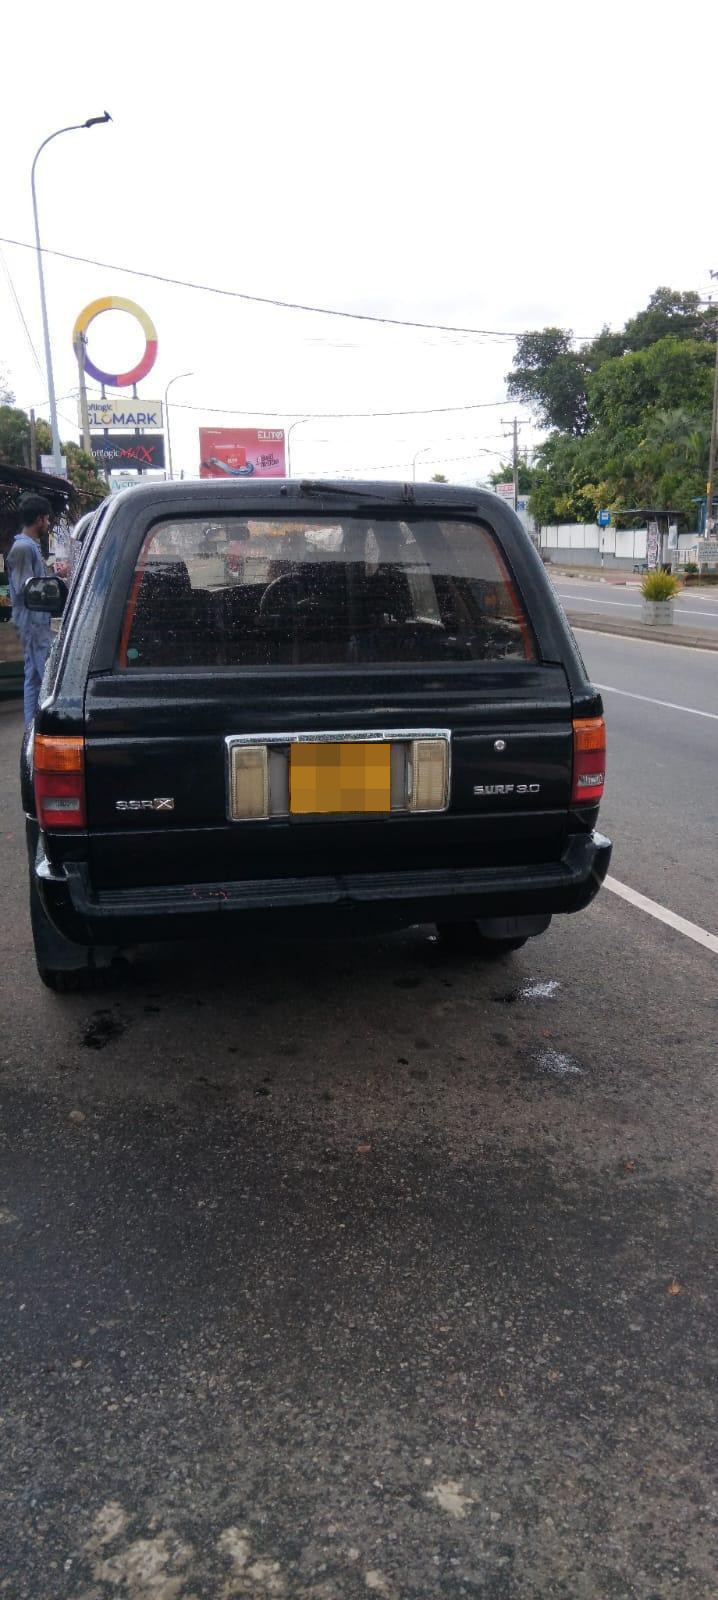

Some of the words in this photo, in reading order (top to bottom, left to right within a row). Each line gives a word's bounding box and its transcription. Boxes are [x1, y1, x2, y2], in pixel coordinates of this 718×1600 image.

[87, 403, 113, 412] oftlogic
[89, 447, 118, 460] oftlogic
[474, 784, 514, 795] SURF
[115, 798, 175, 810] SSRX
